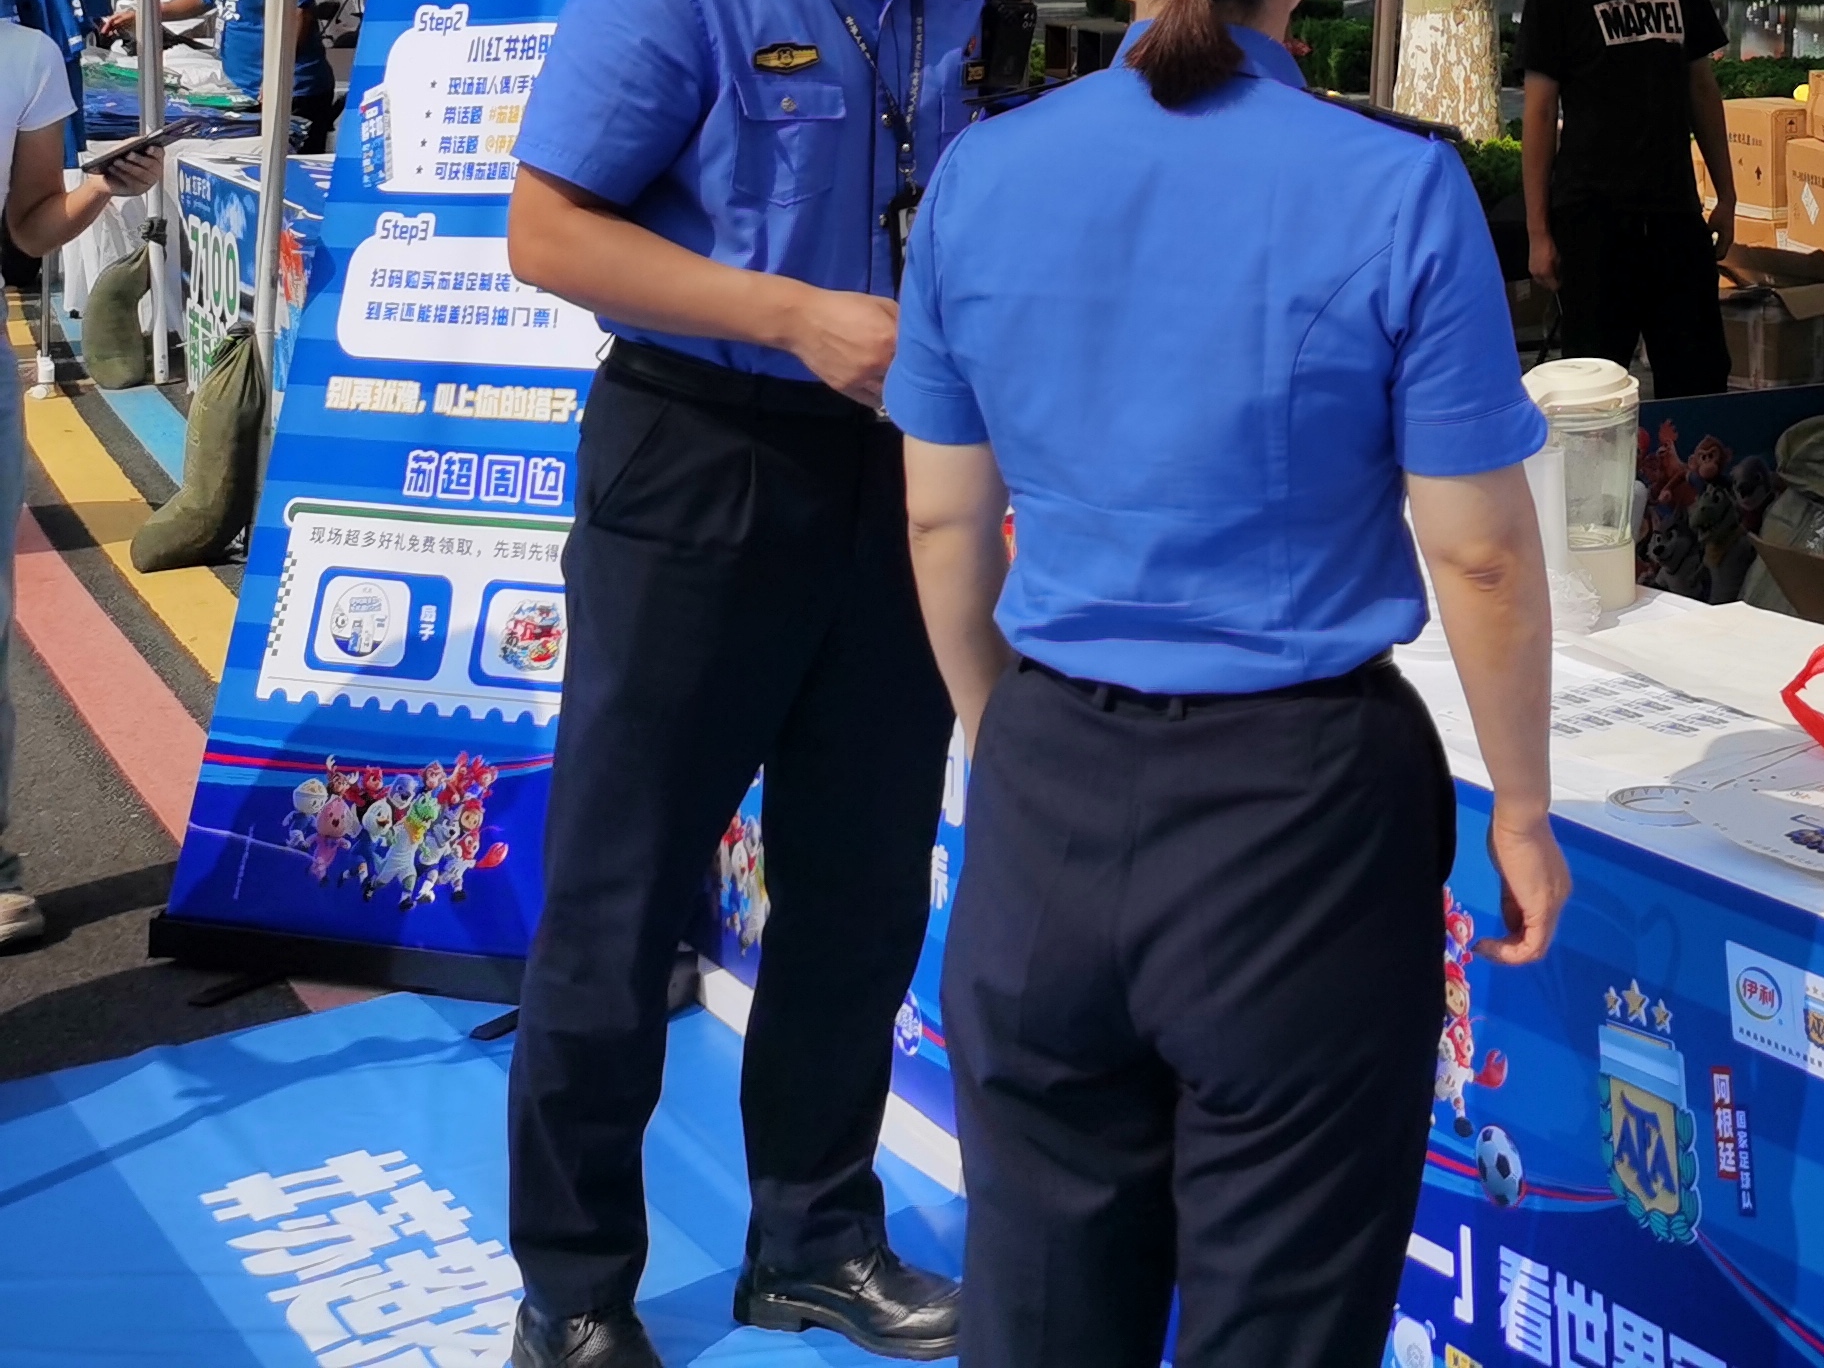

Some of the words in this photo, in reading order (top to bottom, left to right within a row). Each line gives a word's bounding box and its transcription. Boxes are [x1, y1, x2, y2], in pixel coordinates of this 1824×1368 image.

[418, 11, 464, 36] Step2
[1599, 1, 1683, 40] MARVEL
[442, 106, 483, 125] 带话题
[489, 105, 525, 124] #苏超
[438, 135, 479, 155] 带话题
[380, 219, 430, 245] Step3
[189, 214, 240, 327] 7100
[370, 268, 551, 294] 扫码购买苏超定制装，
[404, 450, 565, 505] 苏超周边
[418, 605, 438, 642] 扇子
[1741, 977, 1775, 1009] 伊利
[1713, 1073, 1737, 1173] 阿根廷
[1735, 1110, 1753, 1209] 国家足球队
[1498, 1245, 1728, 1368] 看世界
